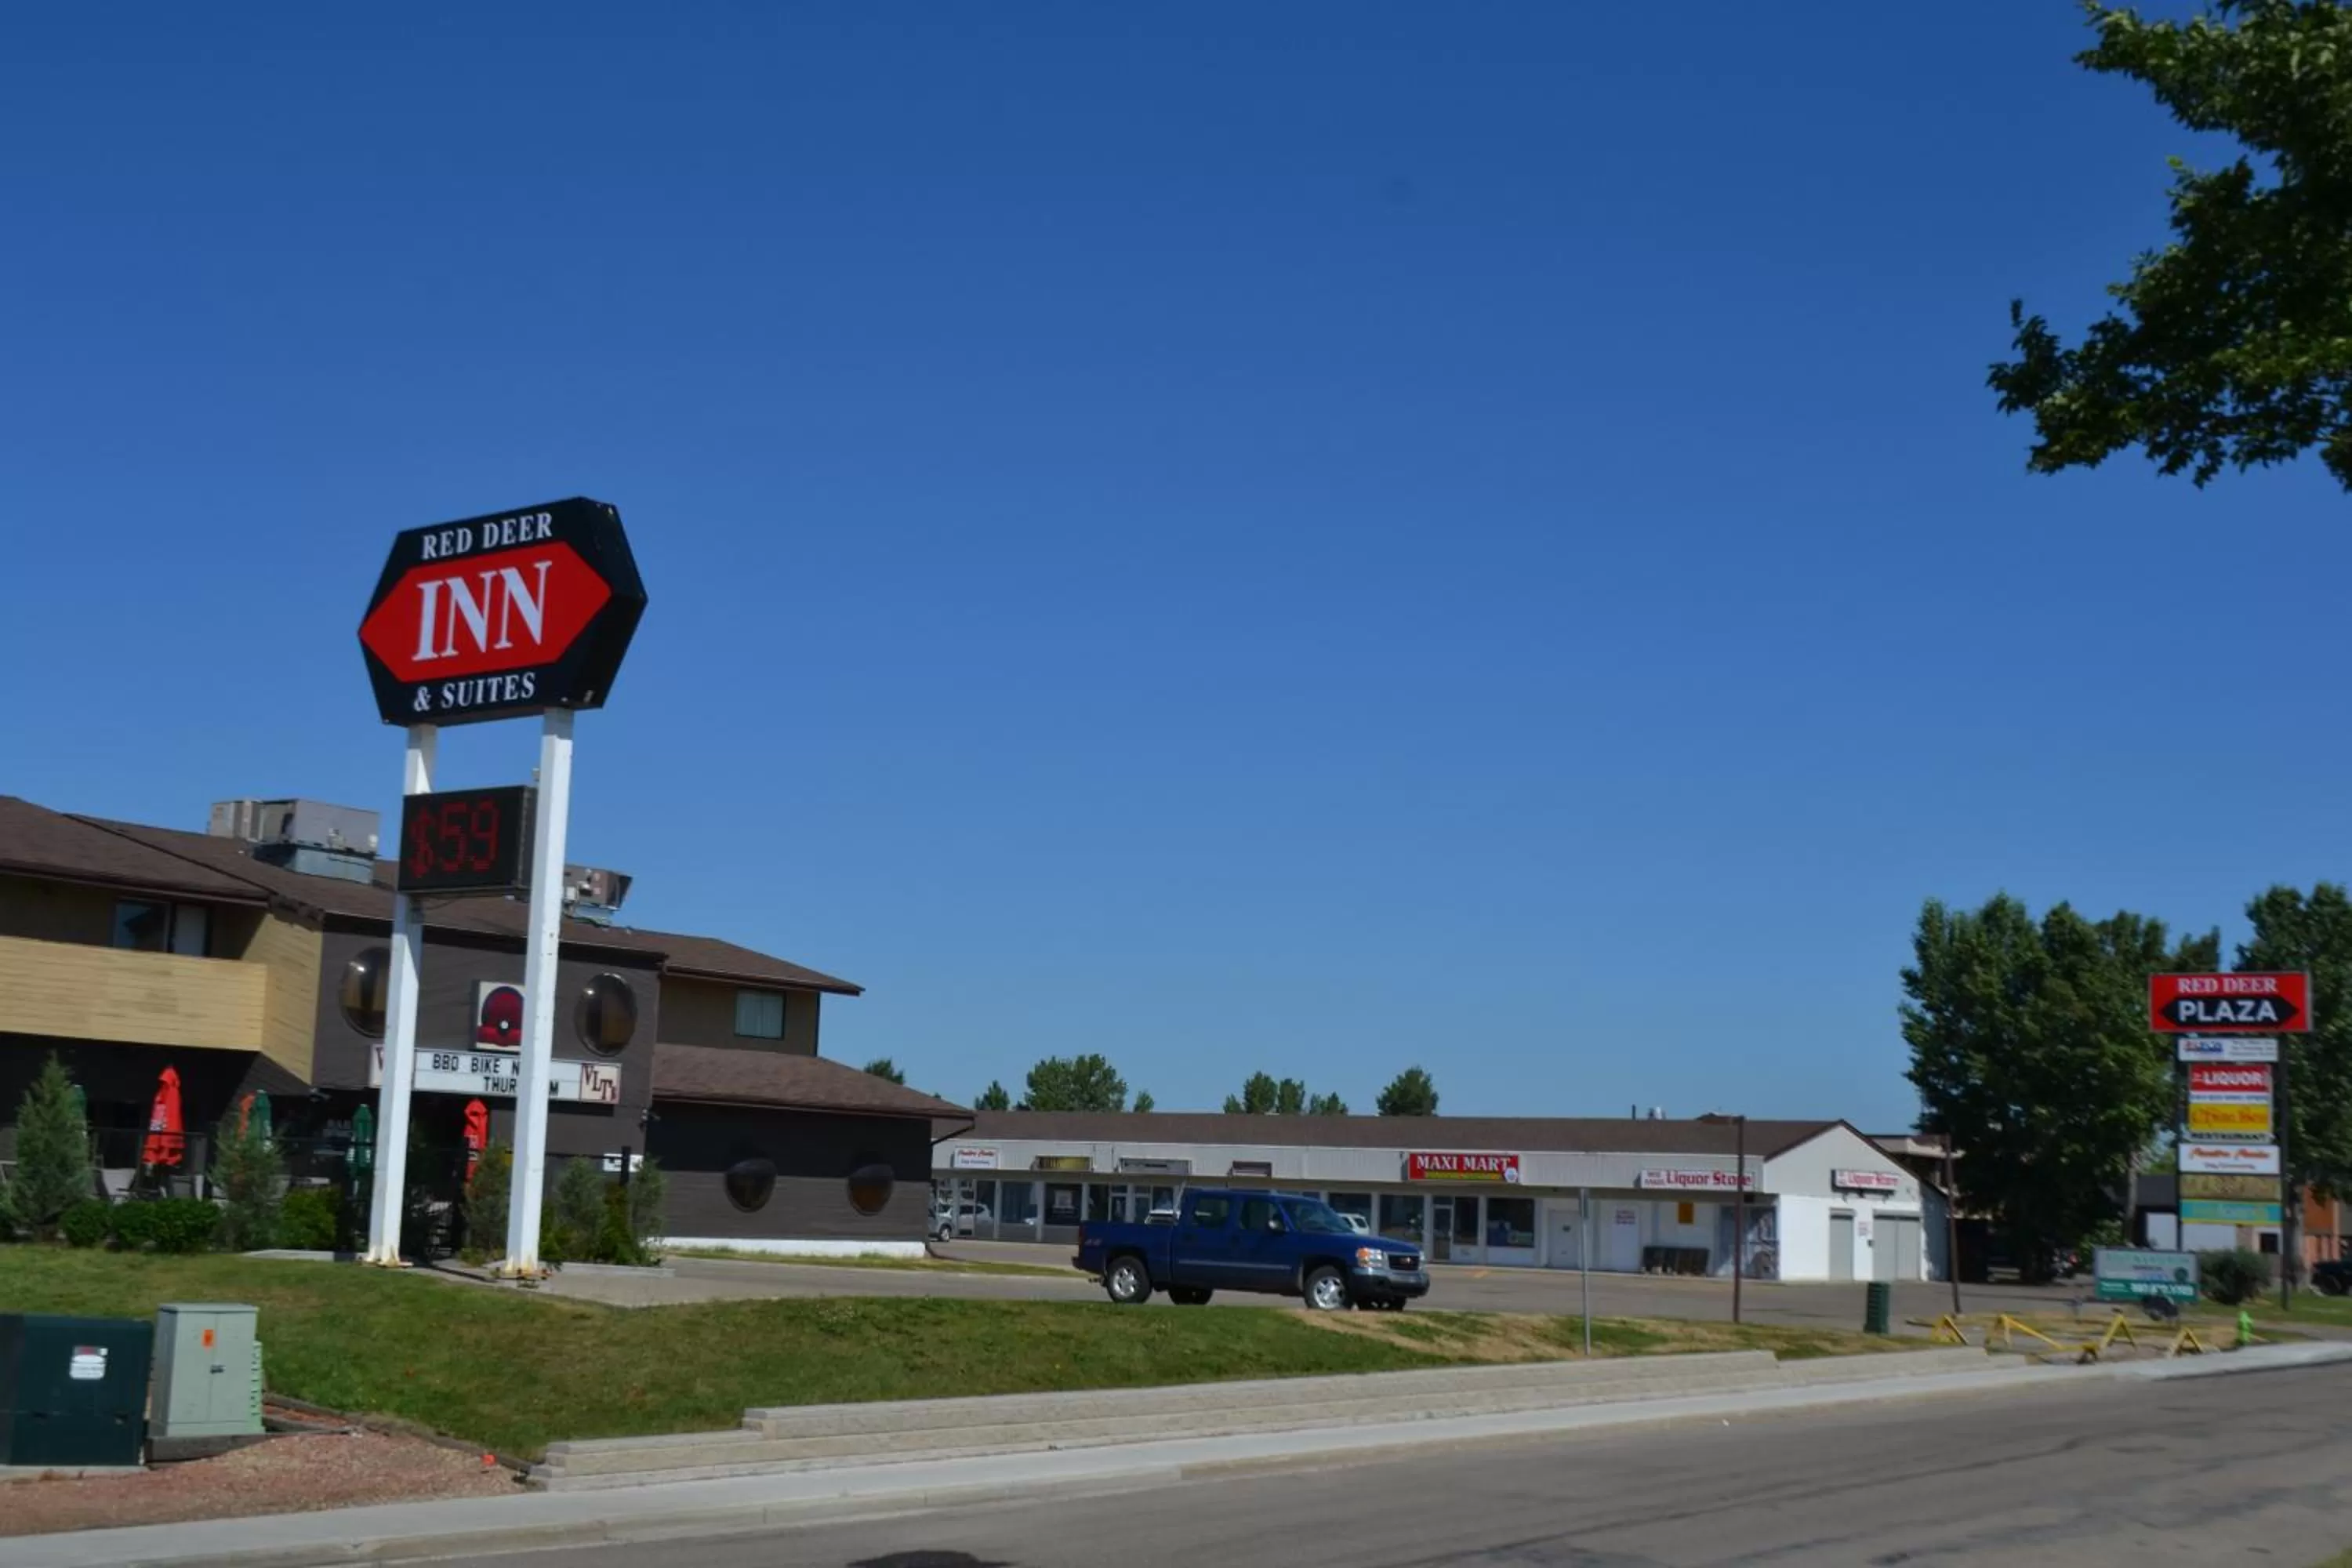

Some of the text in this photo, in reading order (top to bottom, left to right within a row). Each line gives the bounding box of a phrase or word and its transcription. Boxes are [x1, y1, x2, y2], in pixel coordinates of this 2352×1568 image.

[422, 512, 553, 560] RED DEER
[412, 561, 553, 662] INN
[413, 671, 536, 712] & SUITES
[2177, 978, 2278, 993] RED DEER
[2177, 1000, 2278, 1022] PLAZA
[470, 1057, 500, 1073] BIKE
[2203, 1070, 2264, 1086] LIQUOR
[1417, 1155, 1511, 1171] MAXI MART
[1666, 1169, 1710, 1187] Liquor
